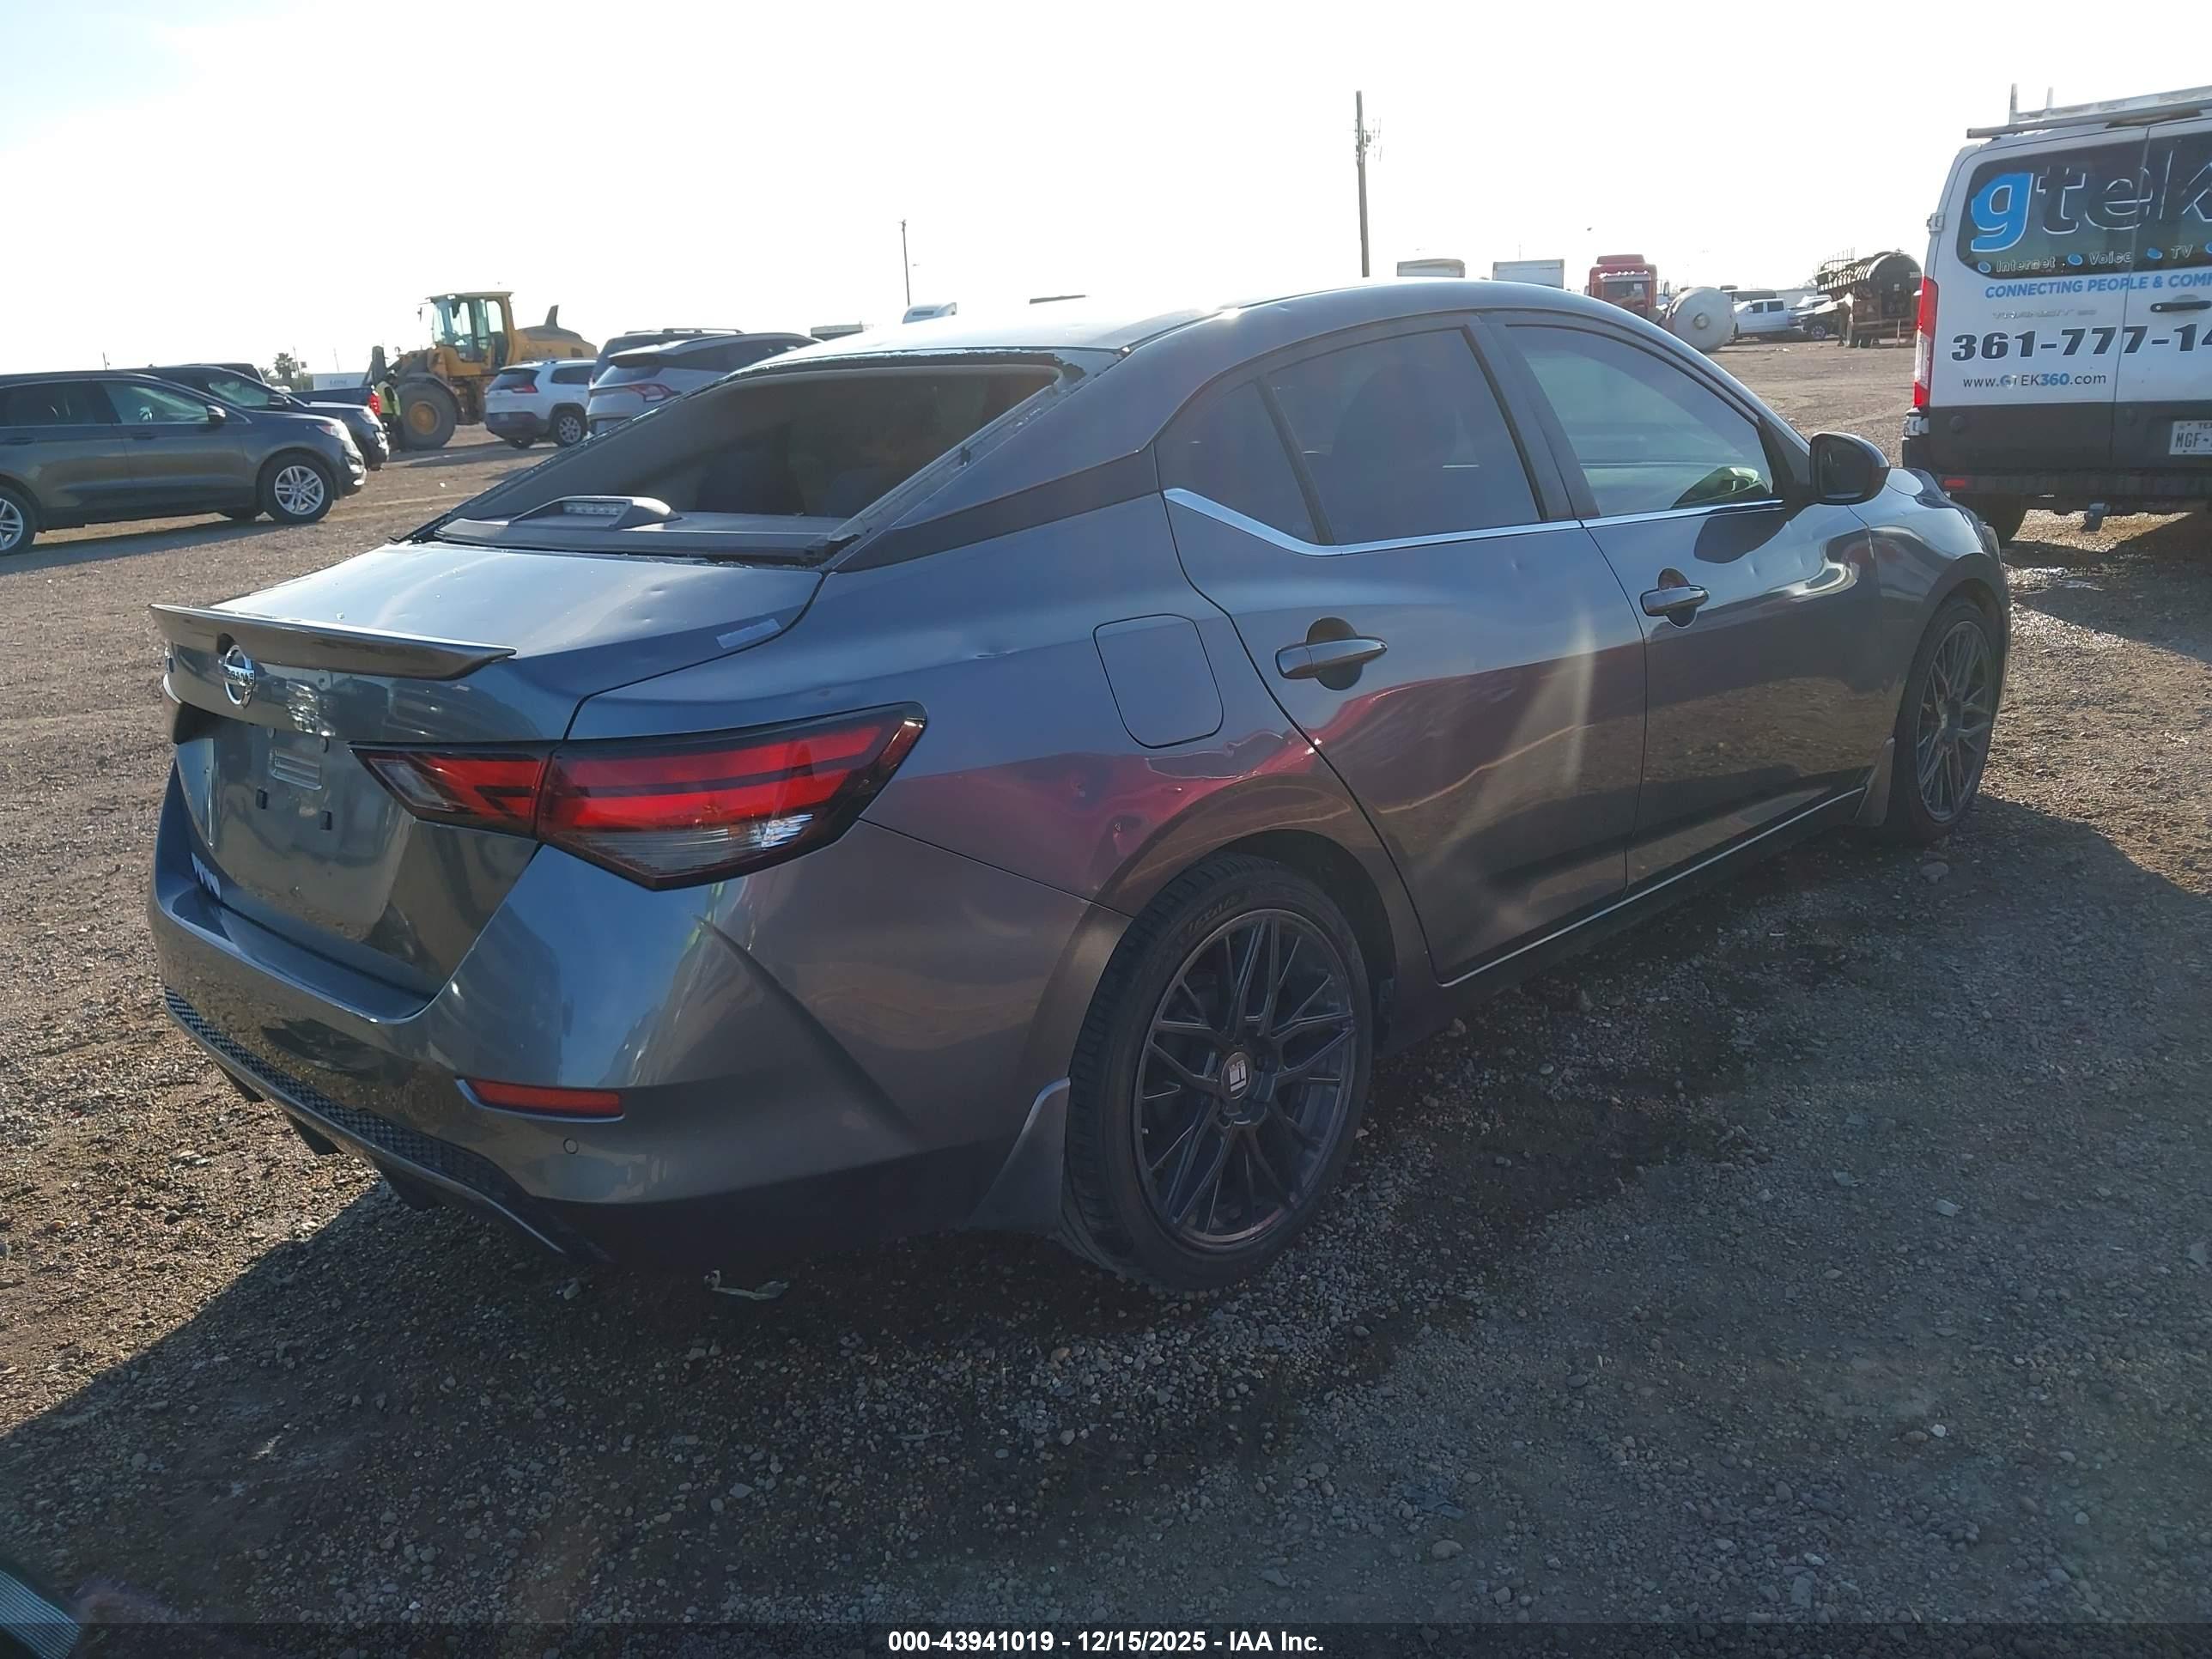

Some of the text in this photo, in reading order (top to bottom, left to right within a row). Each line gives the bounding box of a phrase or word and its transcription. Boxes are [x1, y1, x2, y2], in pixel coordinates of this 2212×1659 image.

[1996, 244, 2193, 272] Internet Voice TV
[1984, 280, 2083, 298] CONNECTING
[2087, 276, 2148, 292] PEOPLE
[2153, 275, 2163, 289] &
[2175, 432, 2212, 448] MGF-
